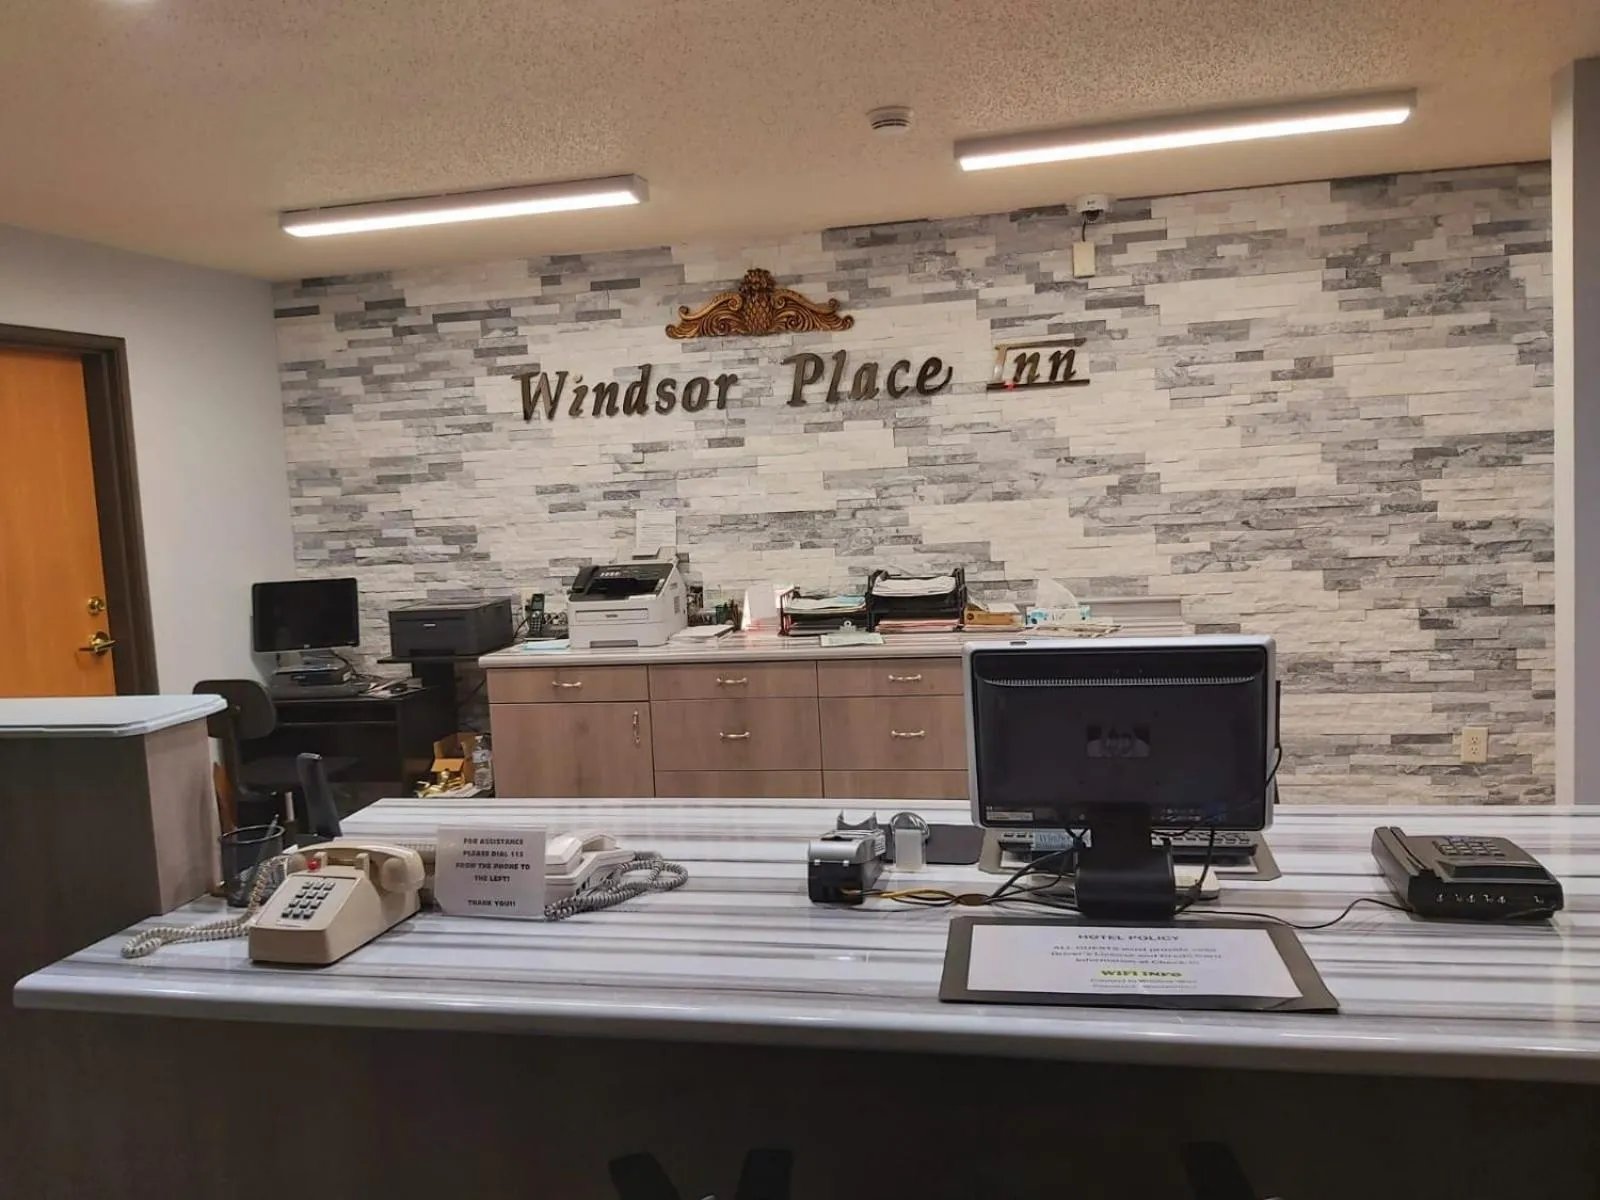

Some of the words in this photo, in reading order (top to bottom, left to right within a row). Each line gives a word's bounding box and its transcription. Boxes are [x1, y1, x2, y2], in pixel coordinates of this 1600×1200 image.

[511, 364, 738, 422] Windsor
[781, 348, 953, 408] Place
[986, 338, 1090, 393] Inn
[520, 863, 531, 871] TO
[1101, 969, 1139, 977] WIFI
